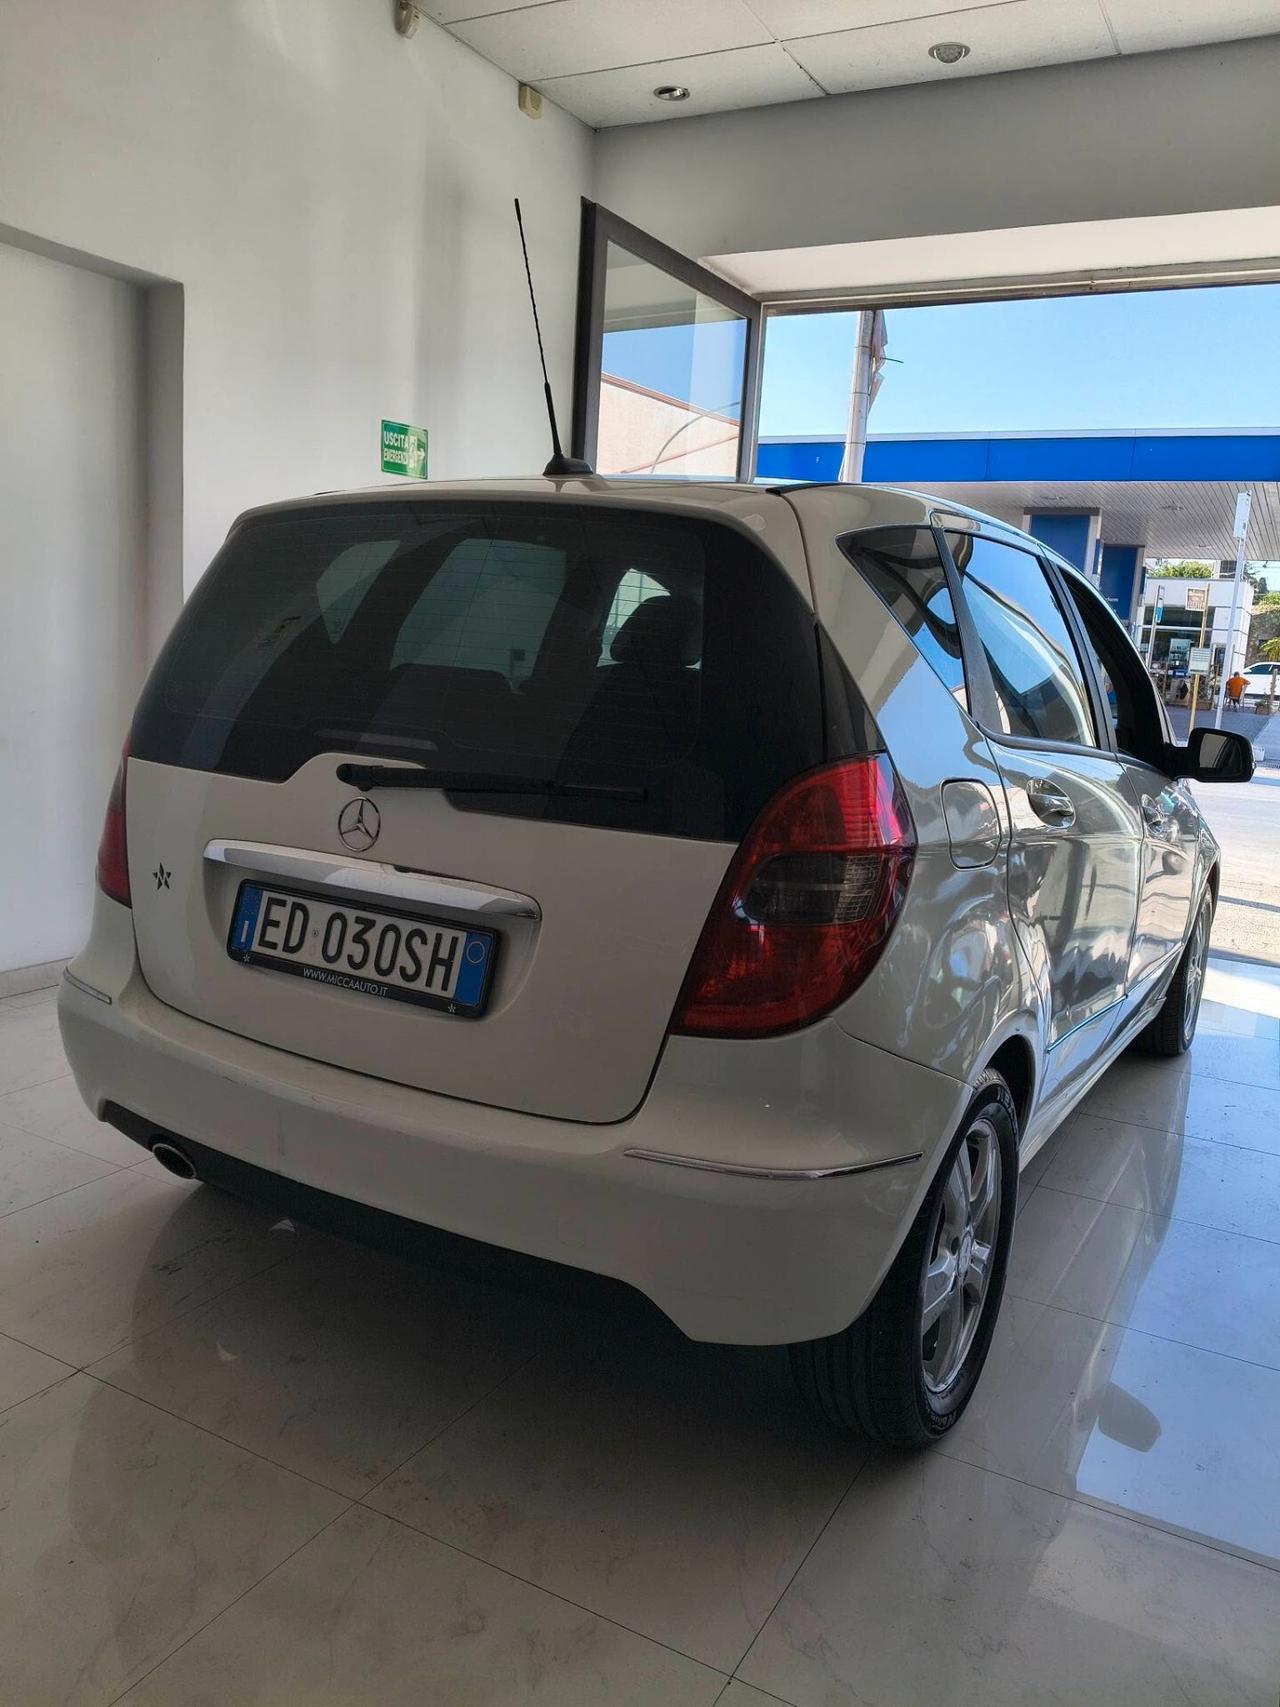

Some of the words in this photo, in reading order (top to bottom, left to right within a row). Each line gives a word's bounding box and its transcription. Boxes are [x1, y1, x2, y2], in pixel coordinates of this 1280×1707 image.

[384, 431, 408, 449] USCITA
[257, 896, 310, 954] ED
[321, 911, 459, 992] 030SH
[303, 967, 389, 997] WWW.MICCAAUTO.IT
